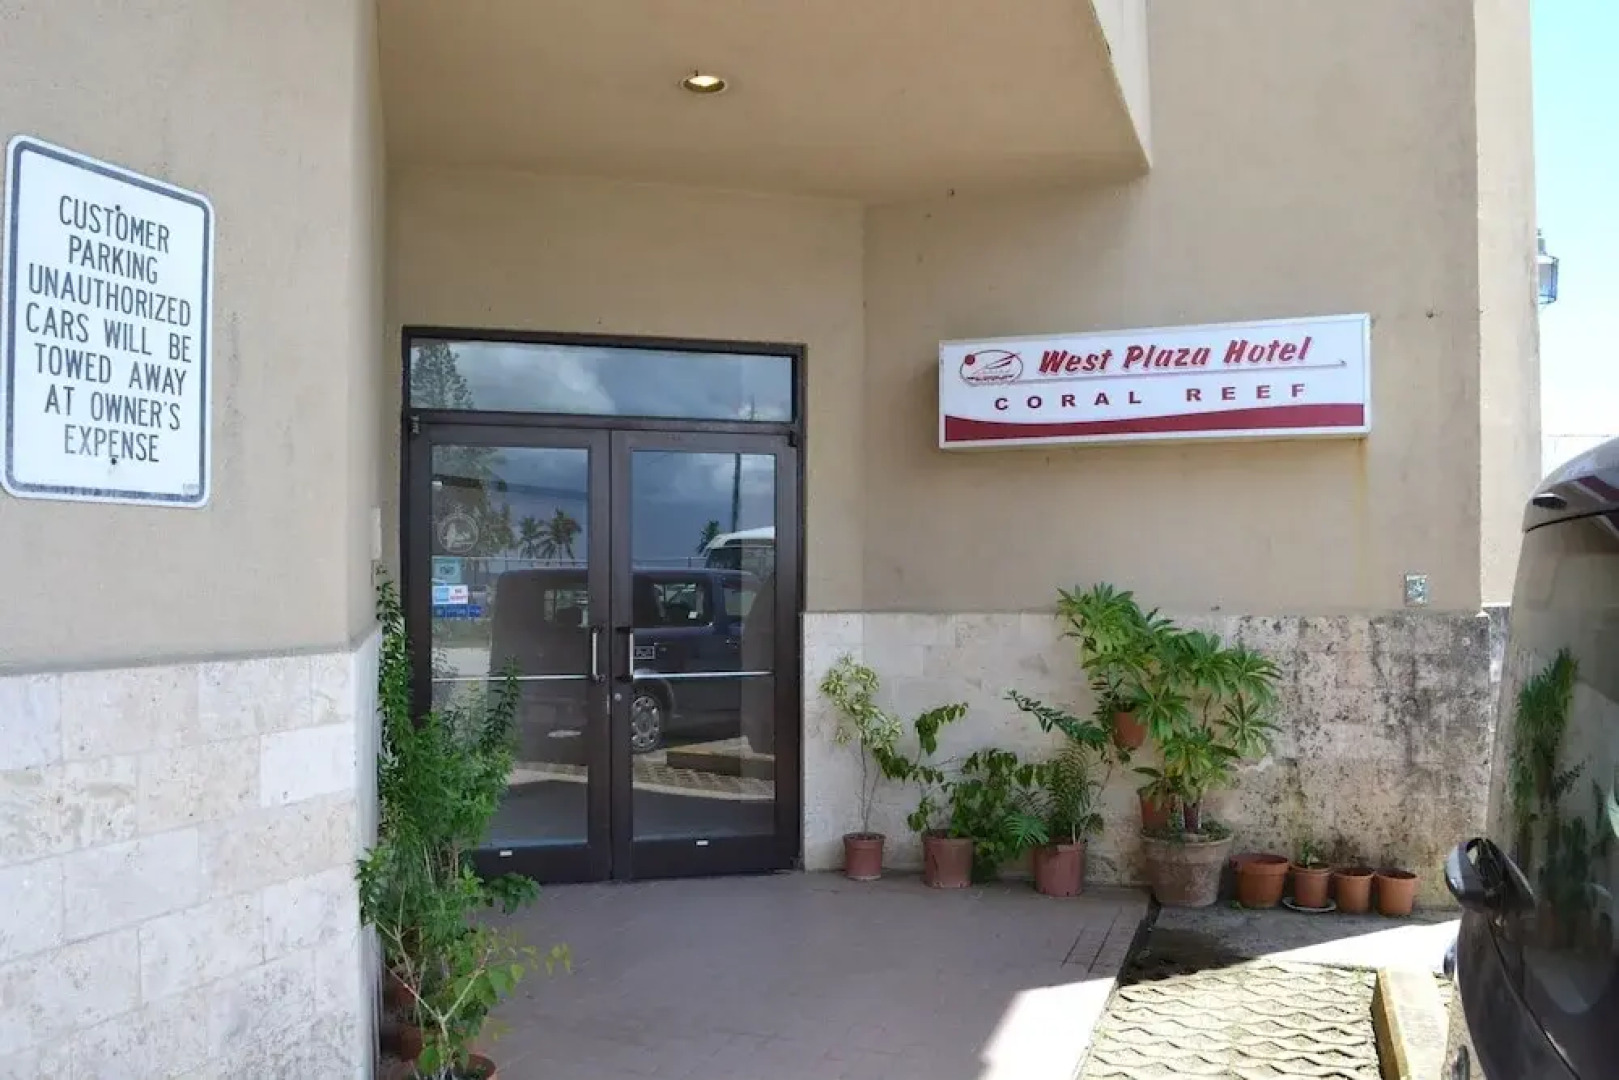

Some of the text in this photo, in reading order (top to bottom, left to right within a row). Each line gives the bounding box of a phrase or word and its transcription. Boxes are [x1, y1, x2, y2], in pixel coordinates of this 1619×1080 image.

[59, 195, 169, 253] CUSTOMER
[68, 235, 157, 284] PARKING
[28, 263, 191, 327] UNAUTHORIZED
[26, 303, 191, 363] CARS WILL BE
[1039, 336, 1312, 375] West Plaza Hotel
[35, 343, 187, 396] TOWED AWAY
[44, 384, 181, 430] AT OWNER'S
[994, 383, 1306, 411] CORAL REEF
[64, 424, 159, 462] EXPENSE
